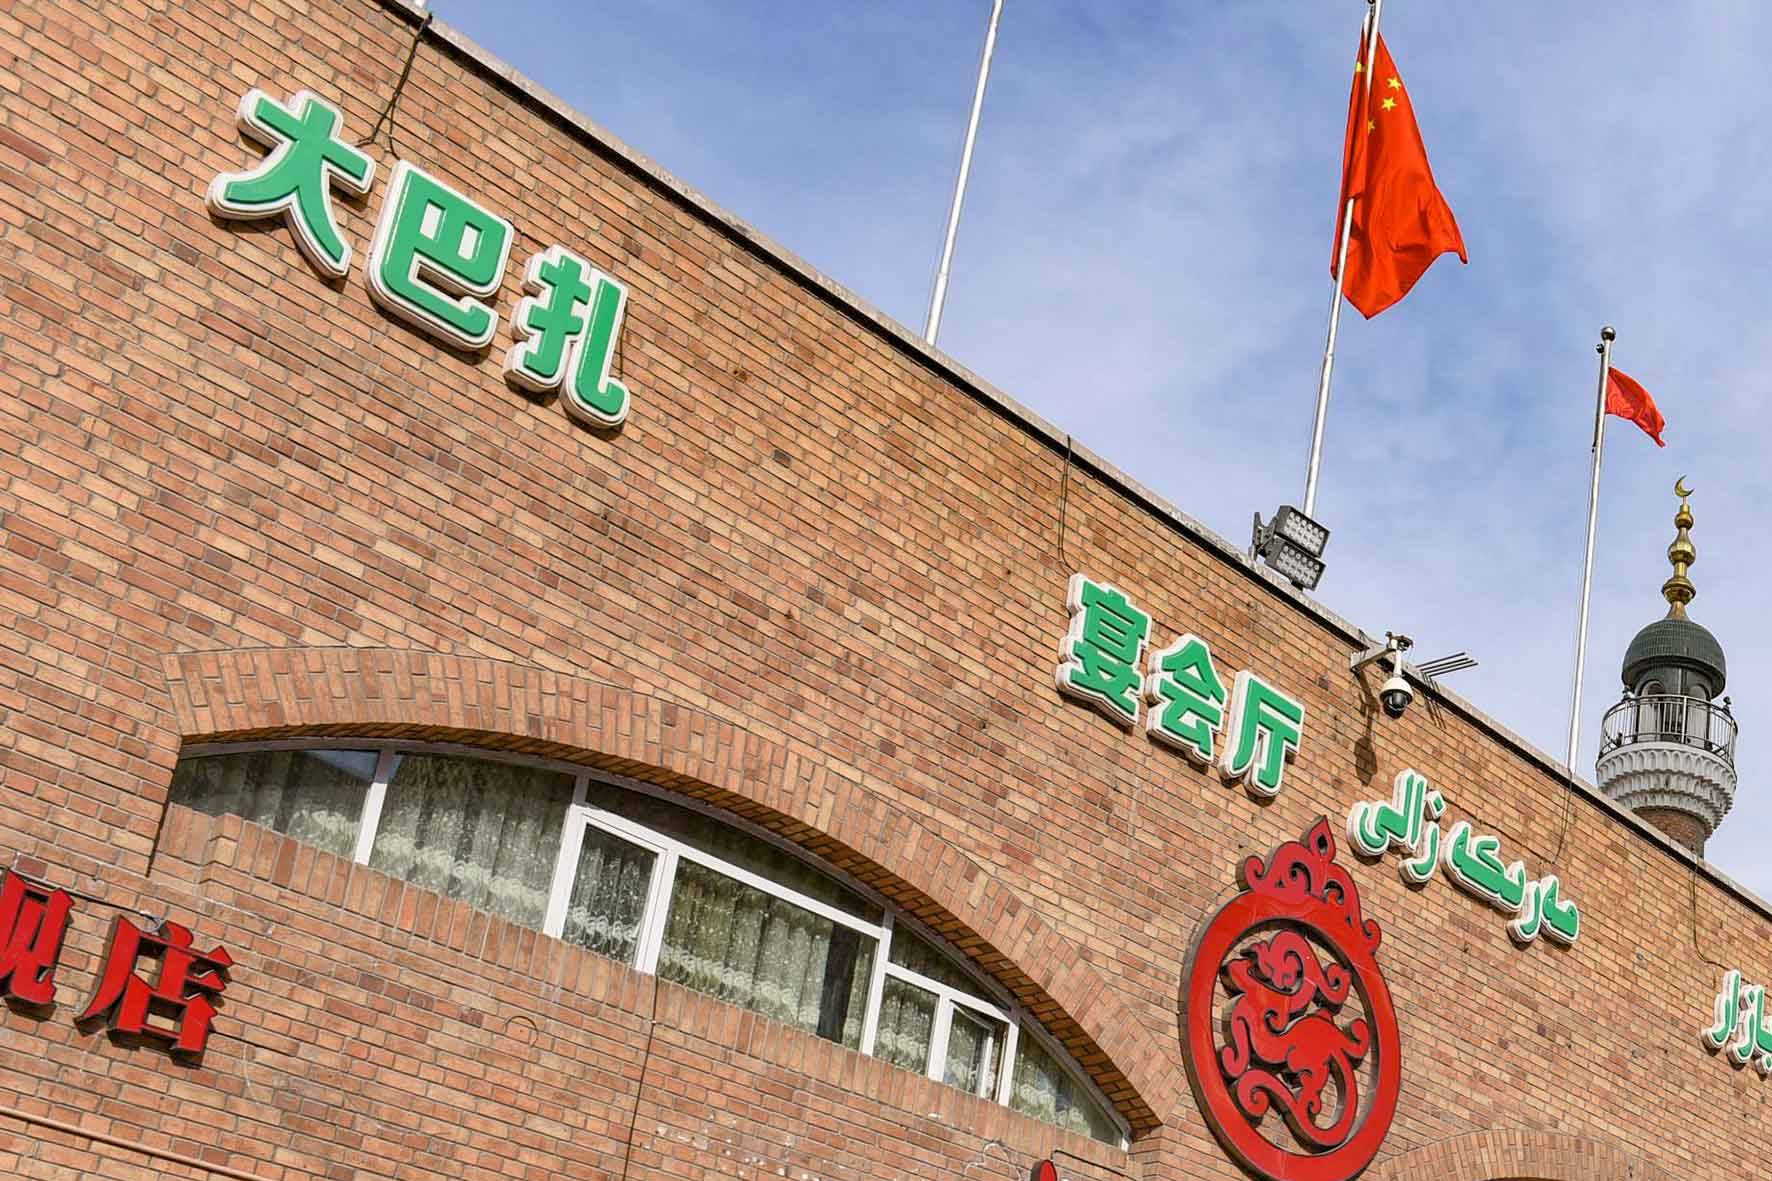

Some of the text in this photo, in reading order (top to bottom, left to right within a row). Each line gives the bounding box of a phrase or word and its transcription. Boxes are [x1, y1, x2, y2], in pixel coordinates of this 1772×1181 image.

[207, 88, 631, 430] 大巴扎
[1056, 573, 1305, 798] 宴会厅
